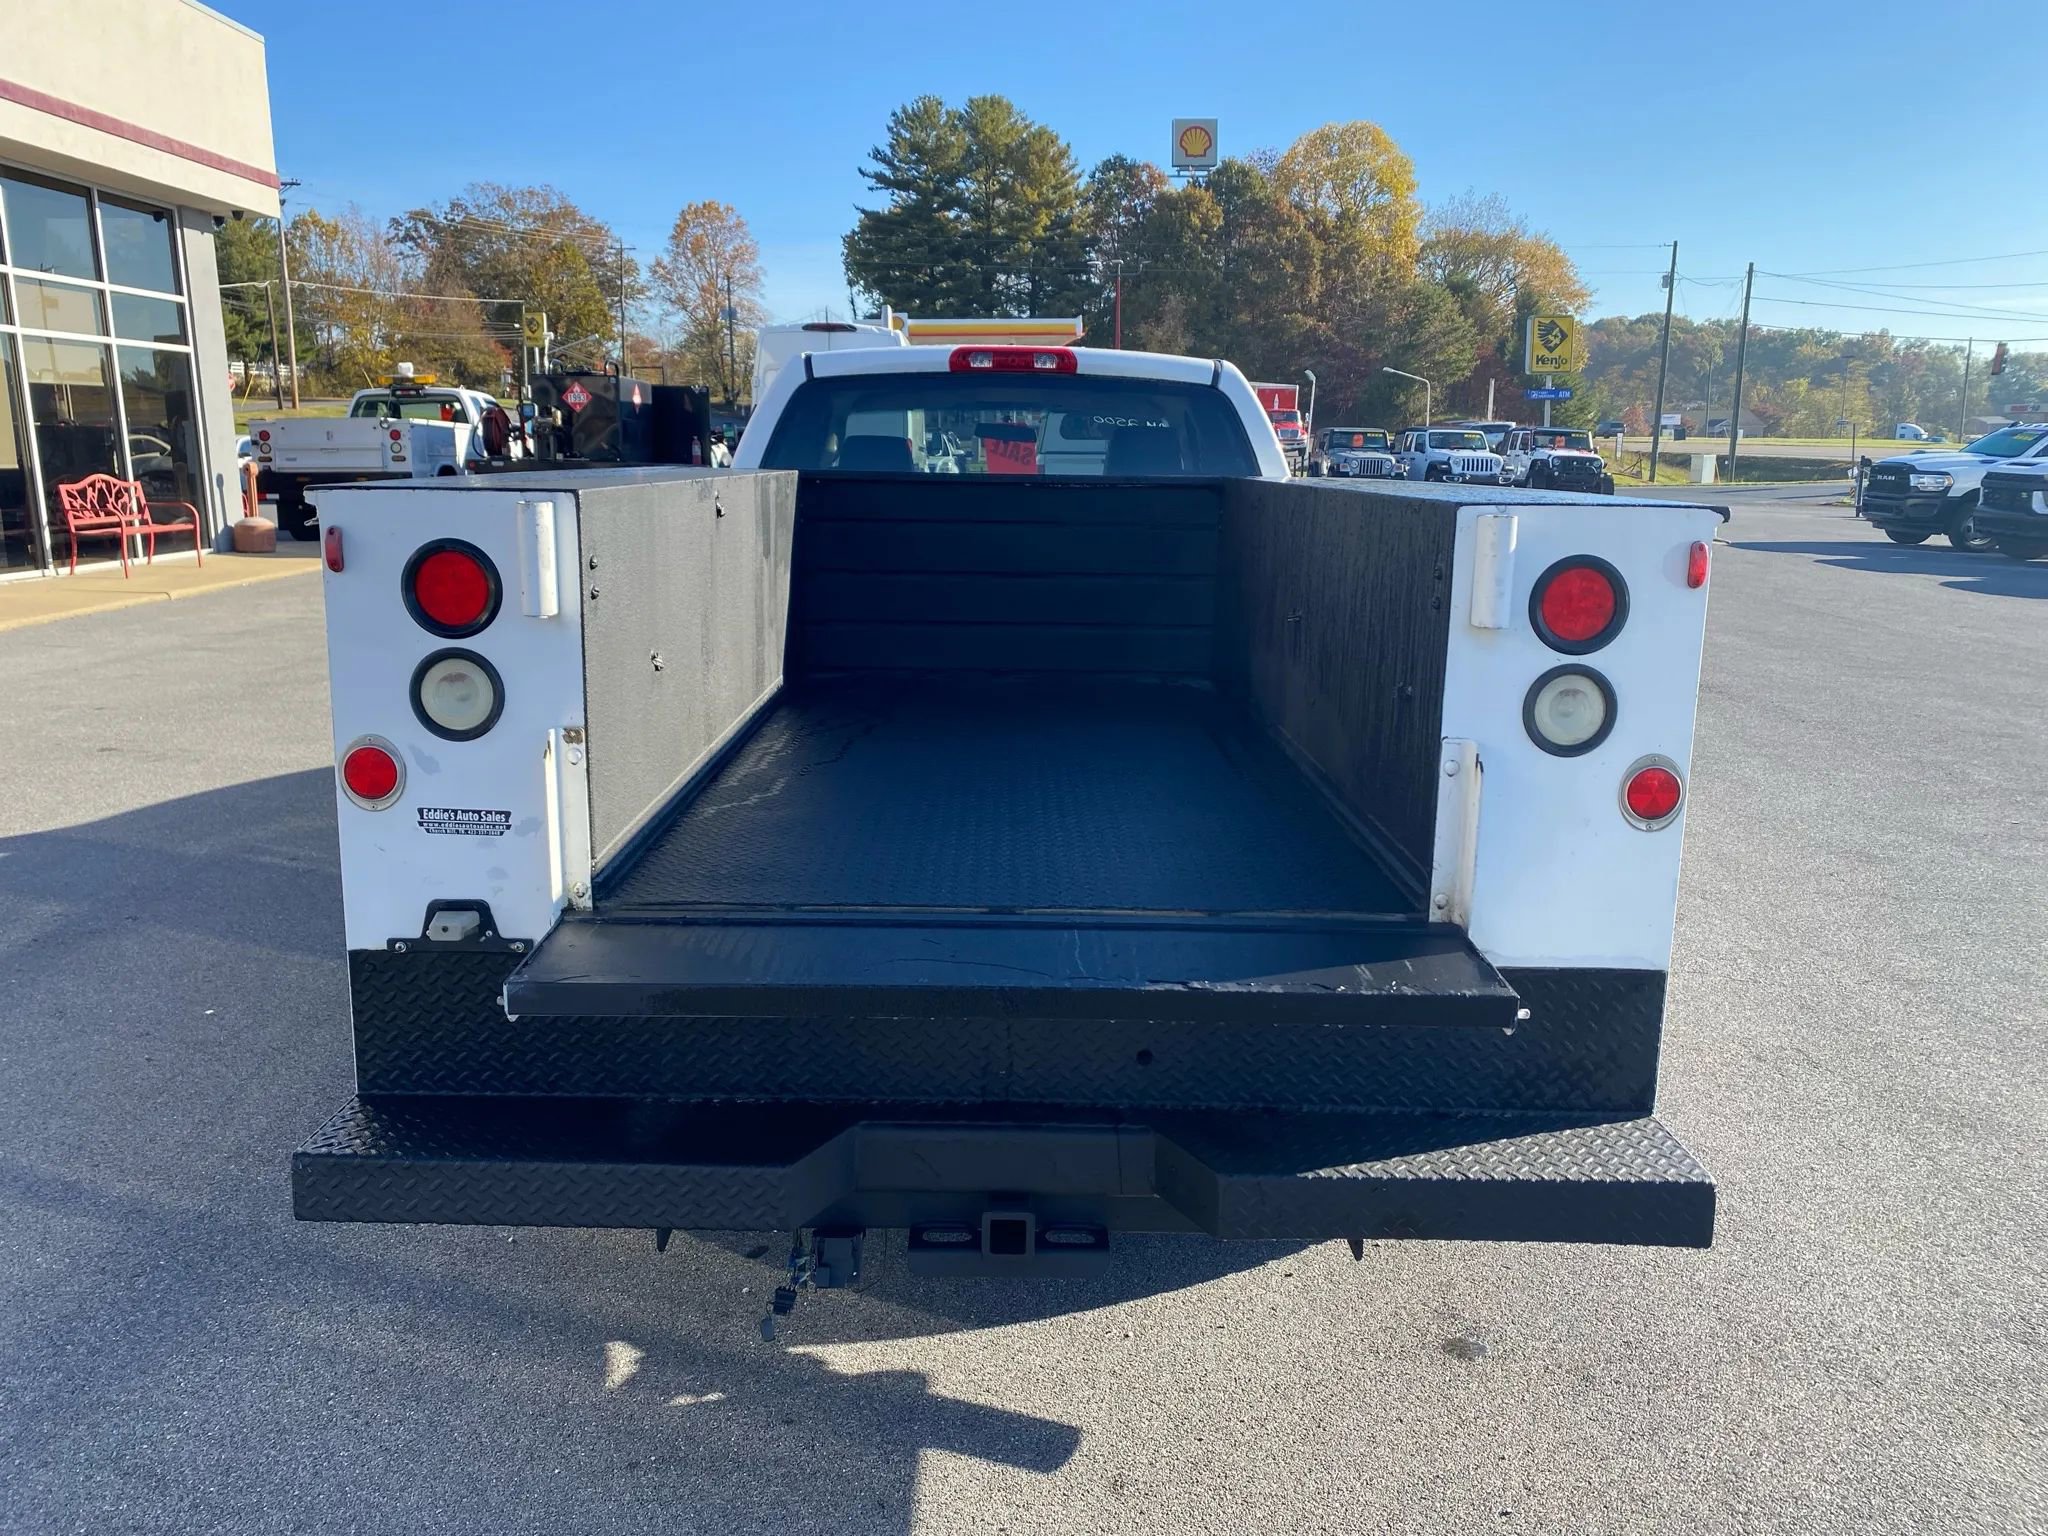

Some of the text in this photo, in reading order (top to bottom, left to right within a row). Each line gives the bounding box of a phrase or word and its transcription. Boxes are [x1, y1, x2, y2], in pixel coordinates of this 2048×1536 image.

[1536, 354, 1568, 370] Kenjo
[423, 808, 506, 822] Eddie's Auto Sales
